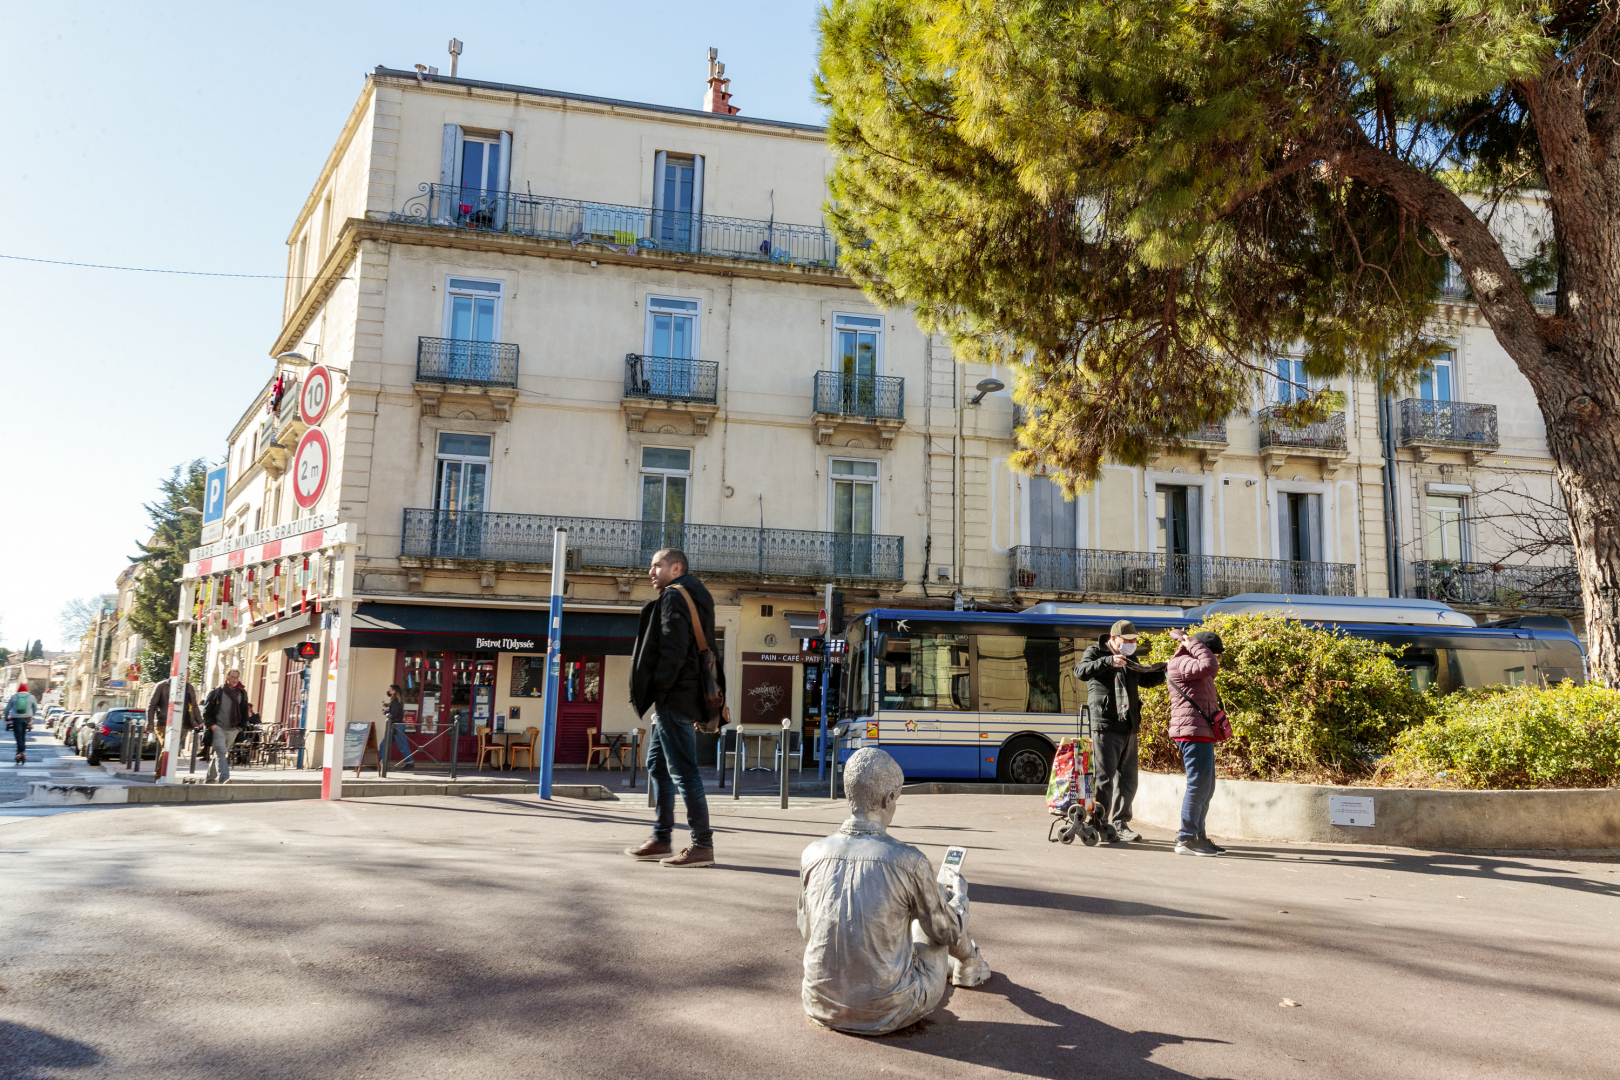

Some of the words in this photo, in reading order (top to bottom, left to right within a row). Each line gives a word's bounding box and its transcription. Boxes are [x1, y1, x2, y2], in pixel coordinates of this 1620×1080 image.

[308, 382, 323, 409] 10
[301, 460, 308, 480] 2
[311, 464, 319, 478] m
[209, 478, 221, 514] P
[197, 545, 214, 560] GARE
[224, 542, 231, 553] 15
[234, 529, 271, 549] MINUTES
[274, 514, 325, 539] GRATUITES
[476, 637, 501, 649] Bistrot
[502, 638, 535, 650] l'Odyssée
[1516, 642, 1533, 651] 221
[782, 654, 800, 662] CAFÉ
